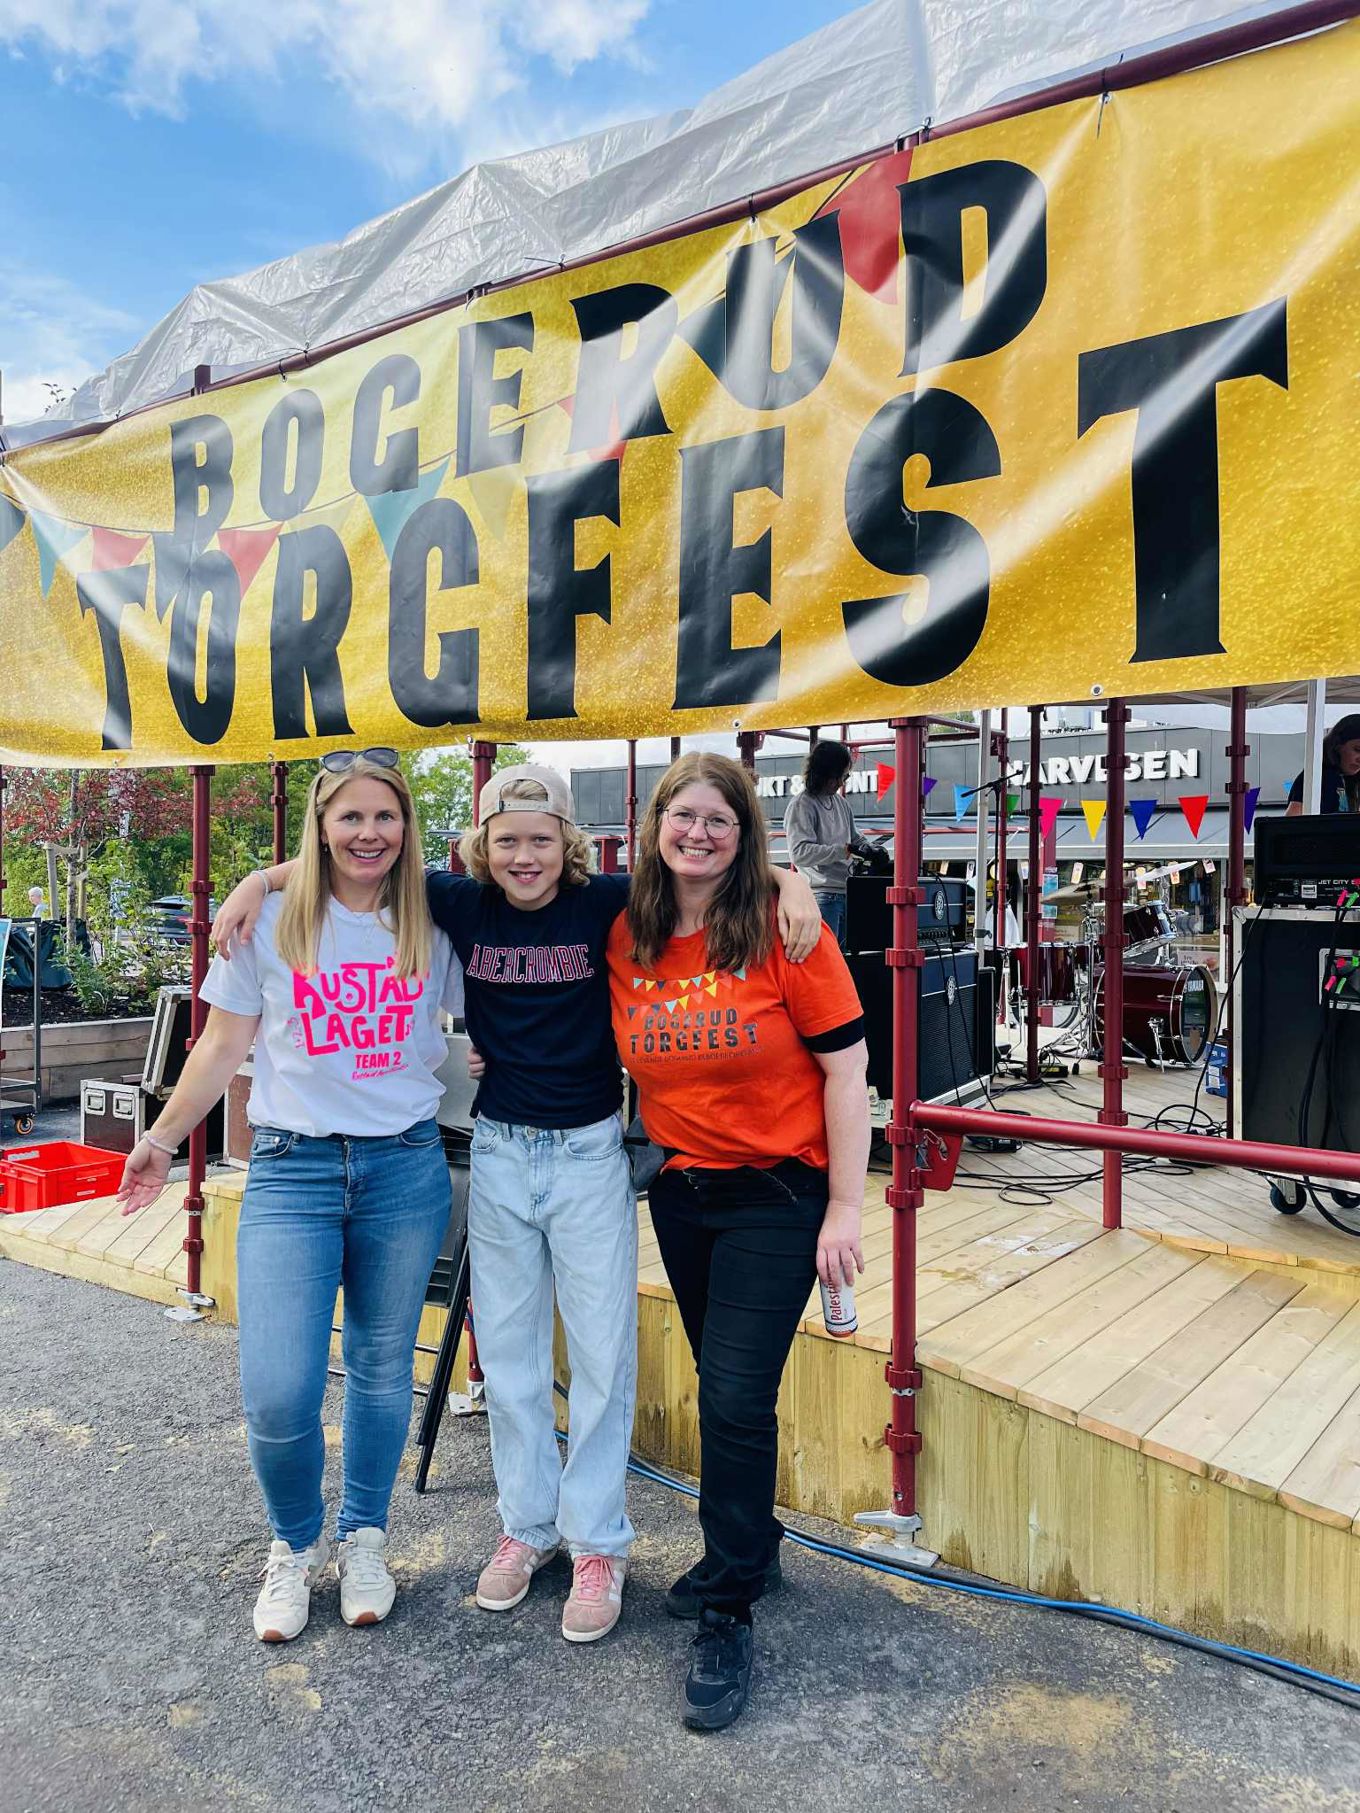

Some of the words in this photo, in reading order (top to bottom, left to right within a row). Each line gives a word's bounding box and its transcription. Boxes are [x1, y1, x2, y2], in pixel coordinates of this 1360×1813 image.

[170, 160, 1047, 548] BOGERUD
[76, 295, 1289, 749] TORGFEST
[466, 944, 594, 983] ABERCROMBIE
[301, 1005, 413, 1056] LAGET
[630, 1023, 758, 1054] TORGFEST
[355, 1053, 389, 1069] TEAM
[393, 1051, 402, 1065] 2
